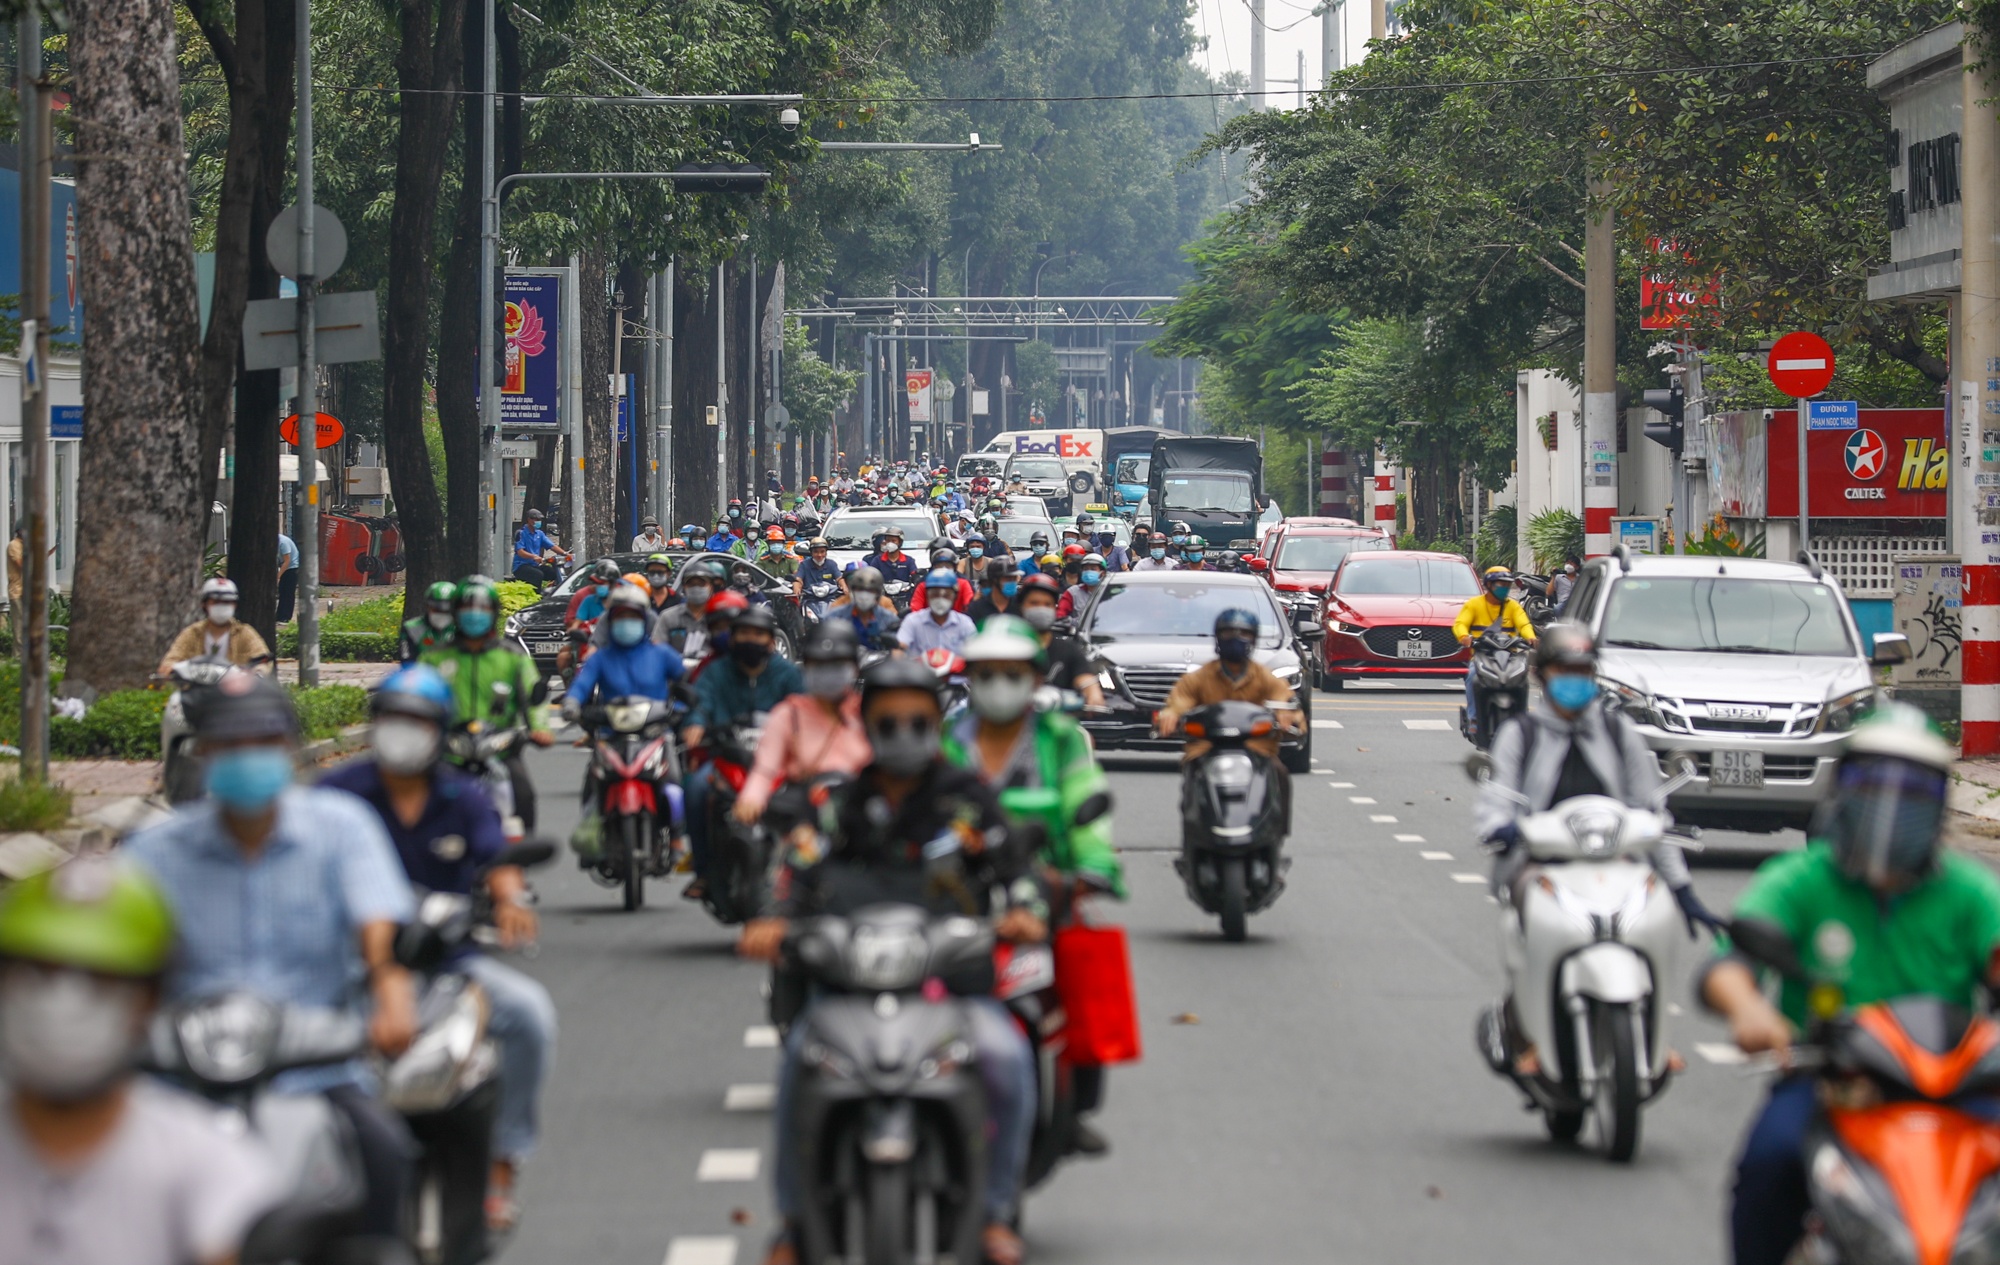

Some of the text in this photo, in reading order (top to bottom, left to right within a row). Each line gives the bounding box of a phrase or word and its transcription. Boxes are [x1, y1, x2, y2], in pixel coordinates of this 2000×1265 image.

[1820, 404, 1848, 413] ĐƯỜNG
[1811, 417, 1826, 428] PHẠM
[1826, 417, 1839, 428] NGỌC
[1016, 434, 1092, 457] FedEx
[1844, 488, 1886, 499] CALTEX
[1407, 642, 1422, 650] 86A
[1711, 707, 1766, 719] ISUZU
[1724, 752, 1752, 768] 51C
